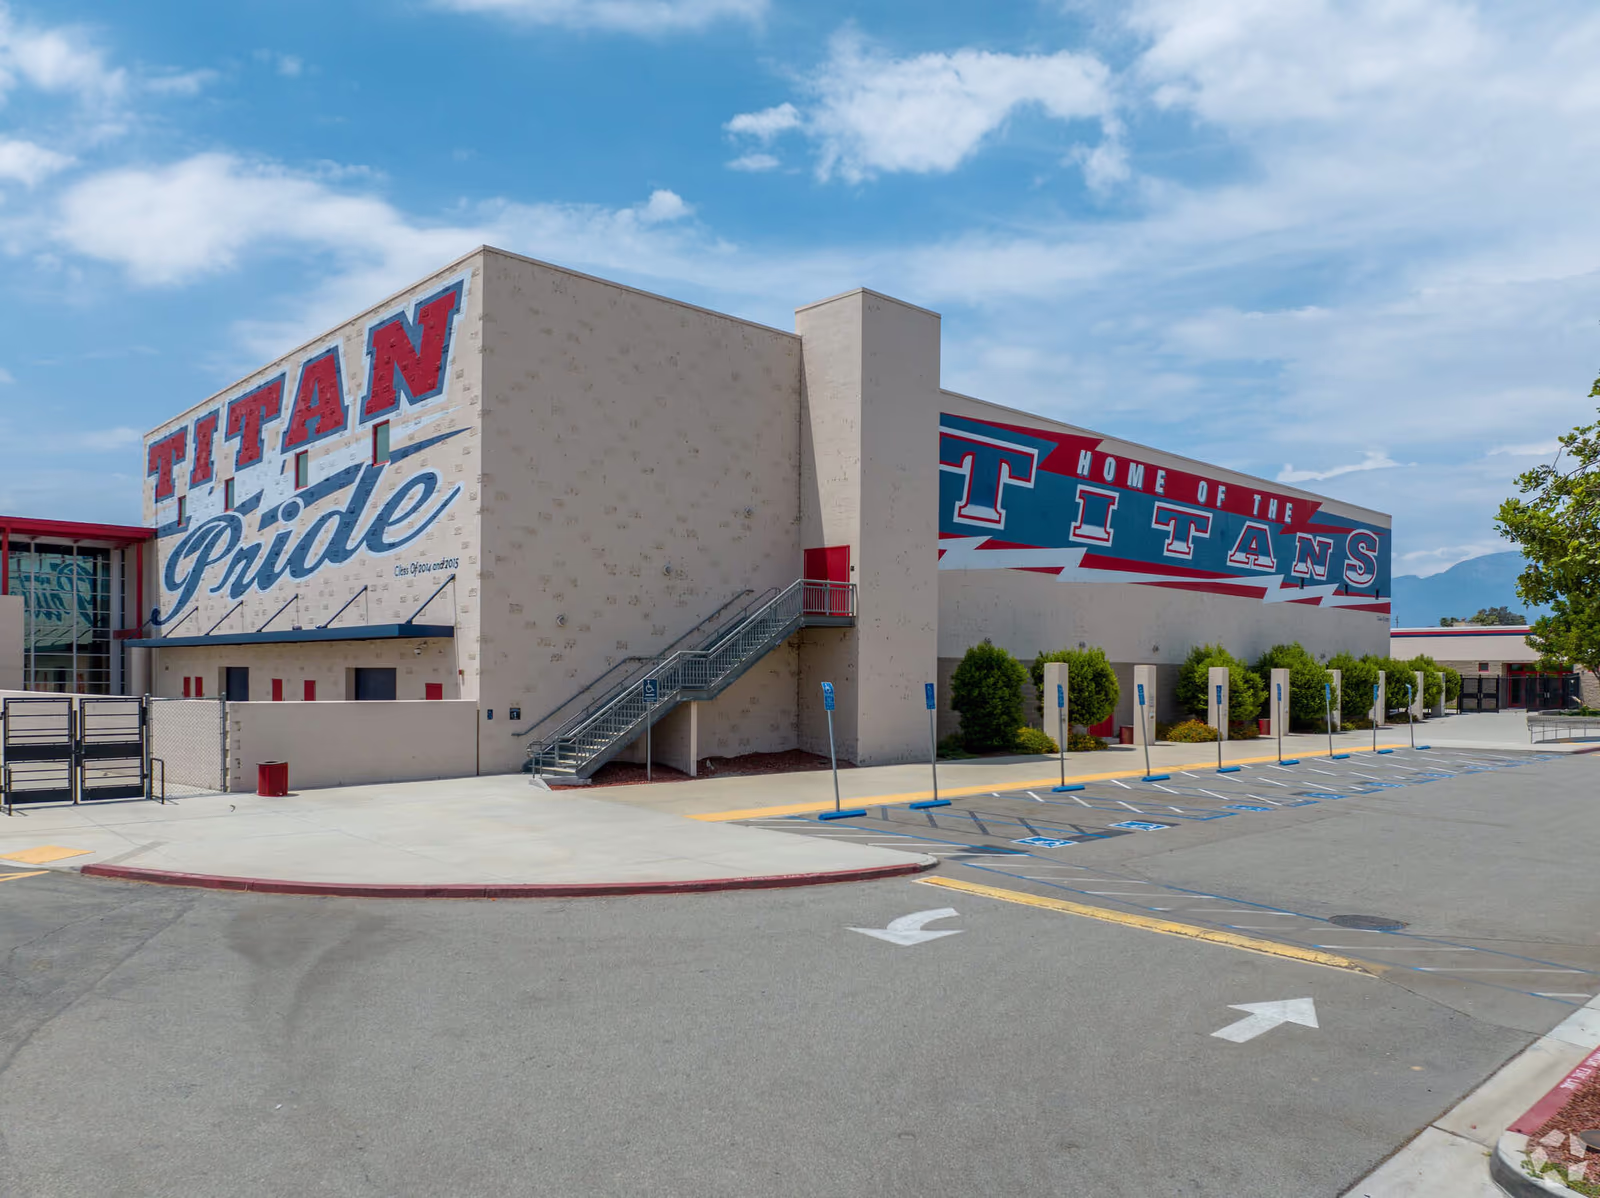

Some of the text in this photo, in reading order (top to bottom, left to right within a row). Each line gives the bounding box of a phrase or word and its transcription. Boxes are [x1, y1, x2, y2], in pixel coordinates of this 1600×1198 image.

[146, 276, 467, 504] TITAN
[151, 460, 462, 626] Pride
[418, 563, 431, 573] 2014
[432, 557, 444, 571] and
[444, 558, 459, 569] 2015
[939, 426, 1378, 587] TITANS
[1077, 450, 1293, 524] HOME OF THE
